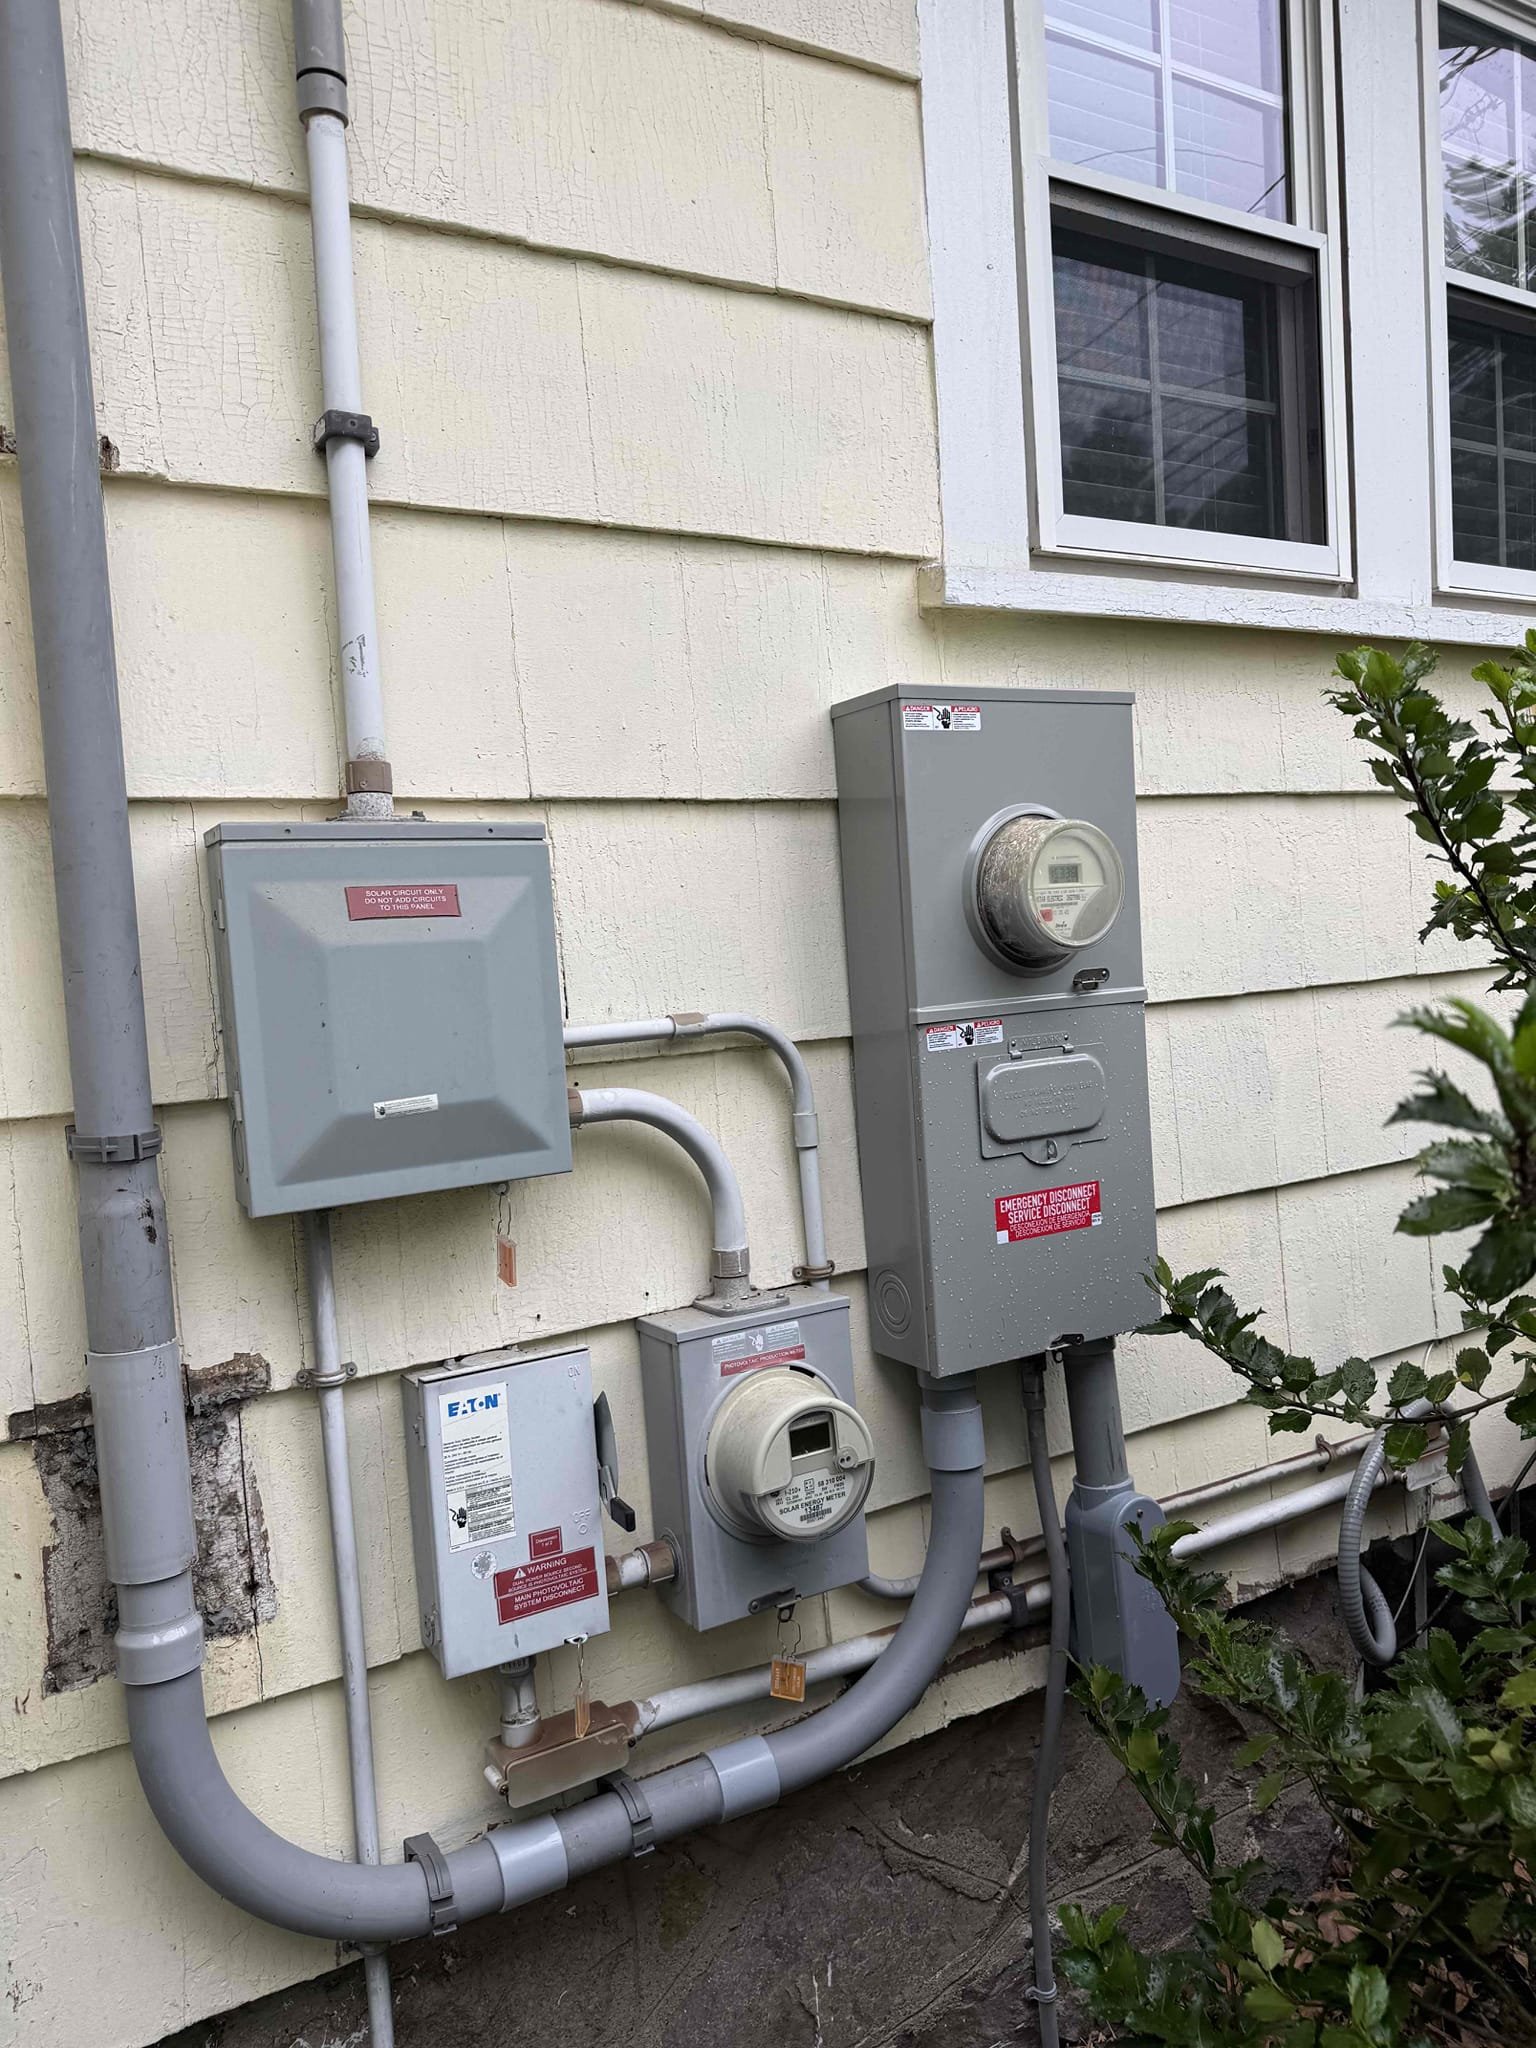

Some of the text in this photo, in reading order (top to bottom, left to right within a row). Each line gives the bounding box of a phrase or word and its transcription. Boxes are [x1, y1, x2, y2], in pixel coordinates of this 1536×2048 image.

[395, 896, 412, 904] ADD
[981, 1019, 1001, 1027] PELIGRO
[1000, 1183, 1097, 1213] EMERGENCY DISCONNECT
[1008, 1197, 1091, 1224] SERVICE DISCONNECT
[1049, 1217, 1056, 1225] DE
[1062, 1218, 1086, 1229] SERVICIO
[568, 1365, 580, 1378] ON
[447, 1393, 499, 1418] EATON
[779, 1504, 800, 1515] SOLAR
[800, 1497, 825, 1509] ENERGY
[825, 1491, 846, 1501] METER
[527, 1557, 568, 1575] WARNING
[514, 1577, 584, 1603] MAIN PHOTOVOLTAIC
[514, 1584, 586, 1611] SYSTEM DISCONNECT
